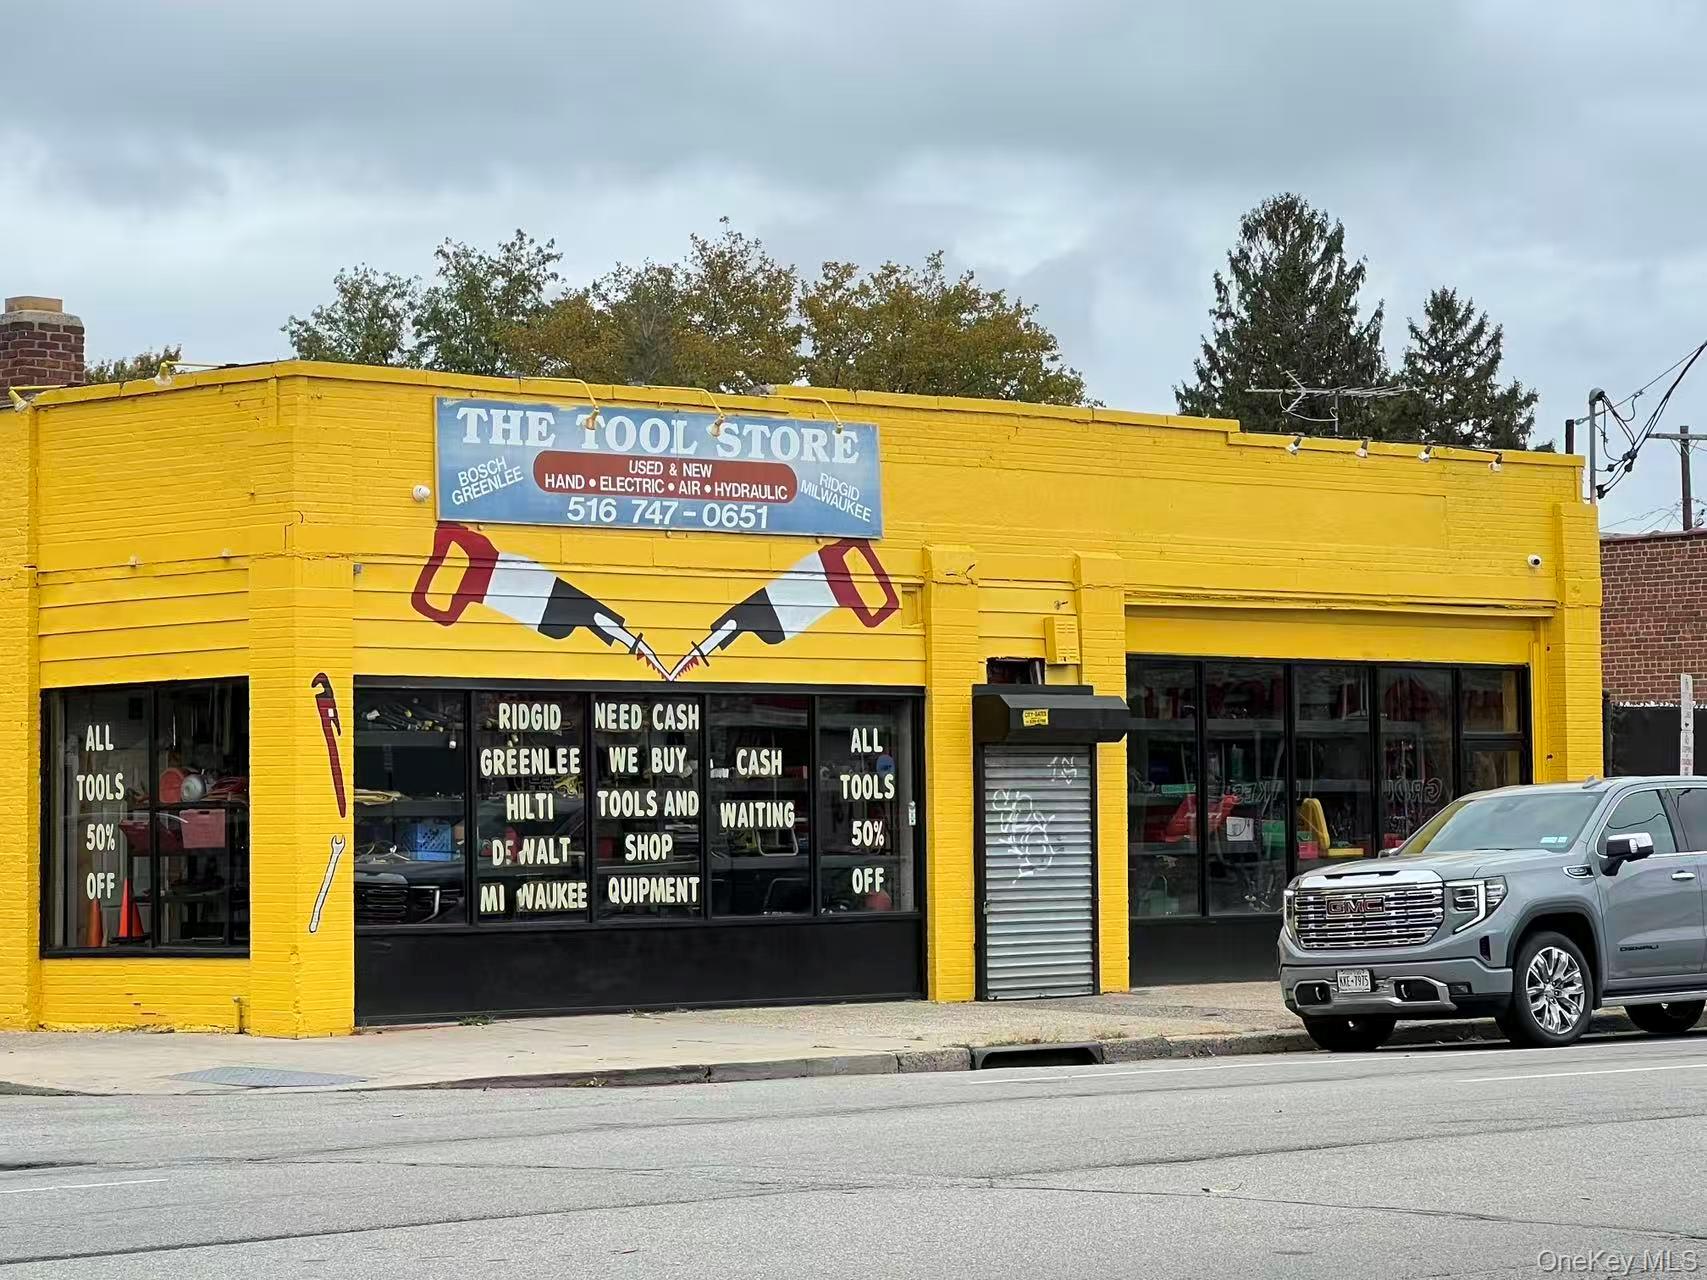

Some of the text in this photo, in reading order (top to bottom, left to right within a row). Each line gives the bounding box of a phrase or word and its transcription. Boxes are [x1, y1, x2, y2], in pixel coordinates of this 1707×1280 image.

[457, 407, 859, 464] THE TOOL STORE
[458, 456, 507, 487] BOSCH
[629, 460, 712, 478] USED & NEW
[451, 466, 524, 505] GREENLEE
[545, 473, 788, 500] HAND ELECTRIC AIR HYDRAULIC
[819, 472, 860, 501] RIDGID
[567, 497, 617, 522] 516
[800, 479, 871, 522] MILWAUKEE
[499, 702, 562, 731] RIDGID
[594, 702, 699, 731] NEED CASH
[86, 724, 114, 752] ALL
[851, 727, 884, 753] ALL
[480, 748, 580, 776] GREENLEE
[609, 746, 687, 773] WE BUY
[736, 748, 782, 776] CASH
[76, 772, 125, 801] TOOLS
[840, 773, 895, 800] TOOLS
[506, 792, 553, 821] HILTI
[597, 789, 699, 817] TOOLS AND
[720, 801, 795, 828] WAITING
[86, 823, 116, 851] 50%
[625, 833, 673, 861] SHOP
[852, 820, 885, 847] 50%
[86, 872, 115, 900] OFF
[608, 876, 700, 904] QUIPMENT
[852, 867, 885, 894] OFF
[1328, 898, 1382, 914] GMC
[1619, 944, 1660, 952] DENALI
